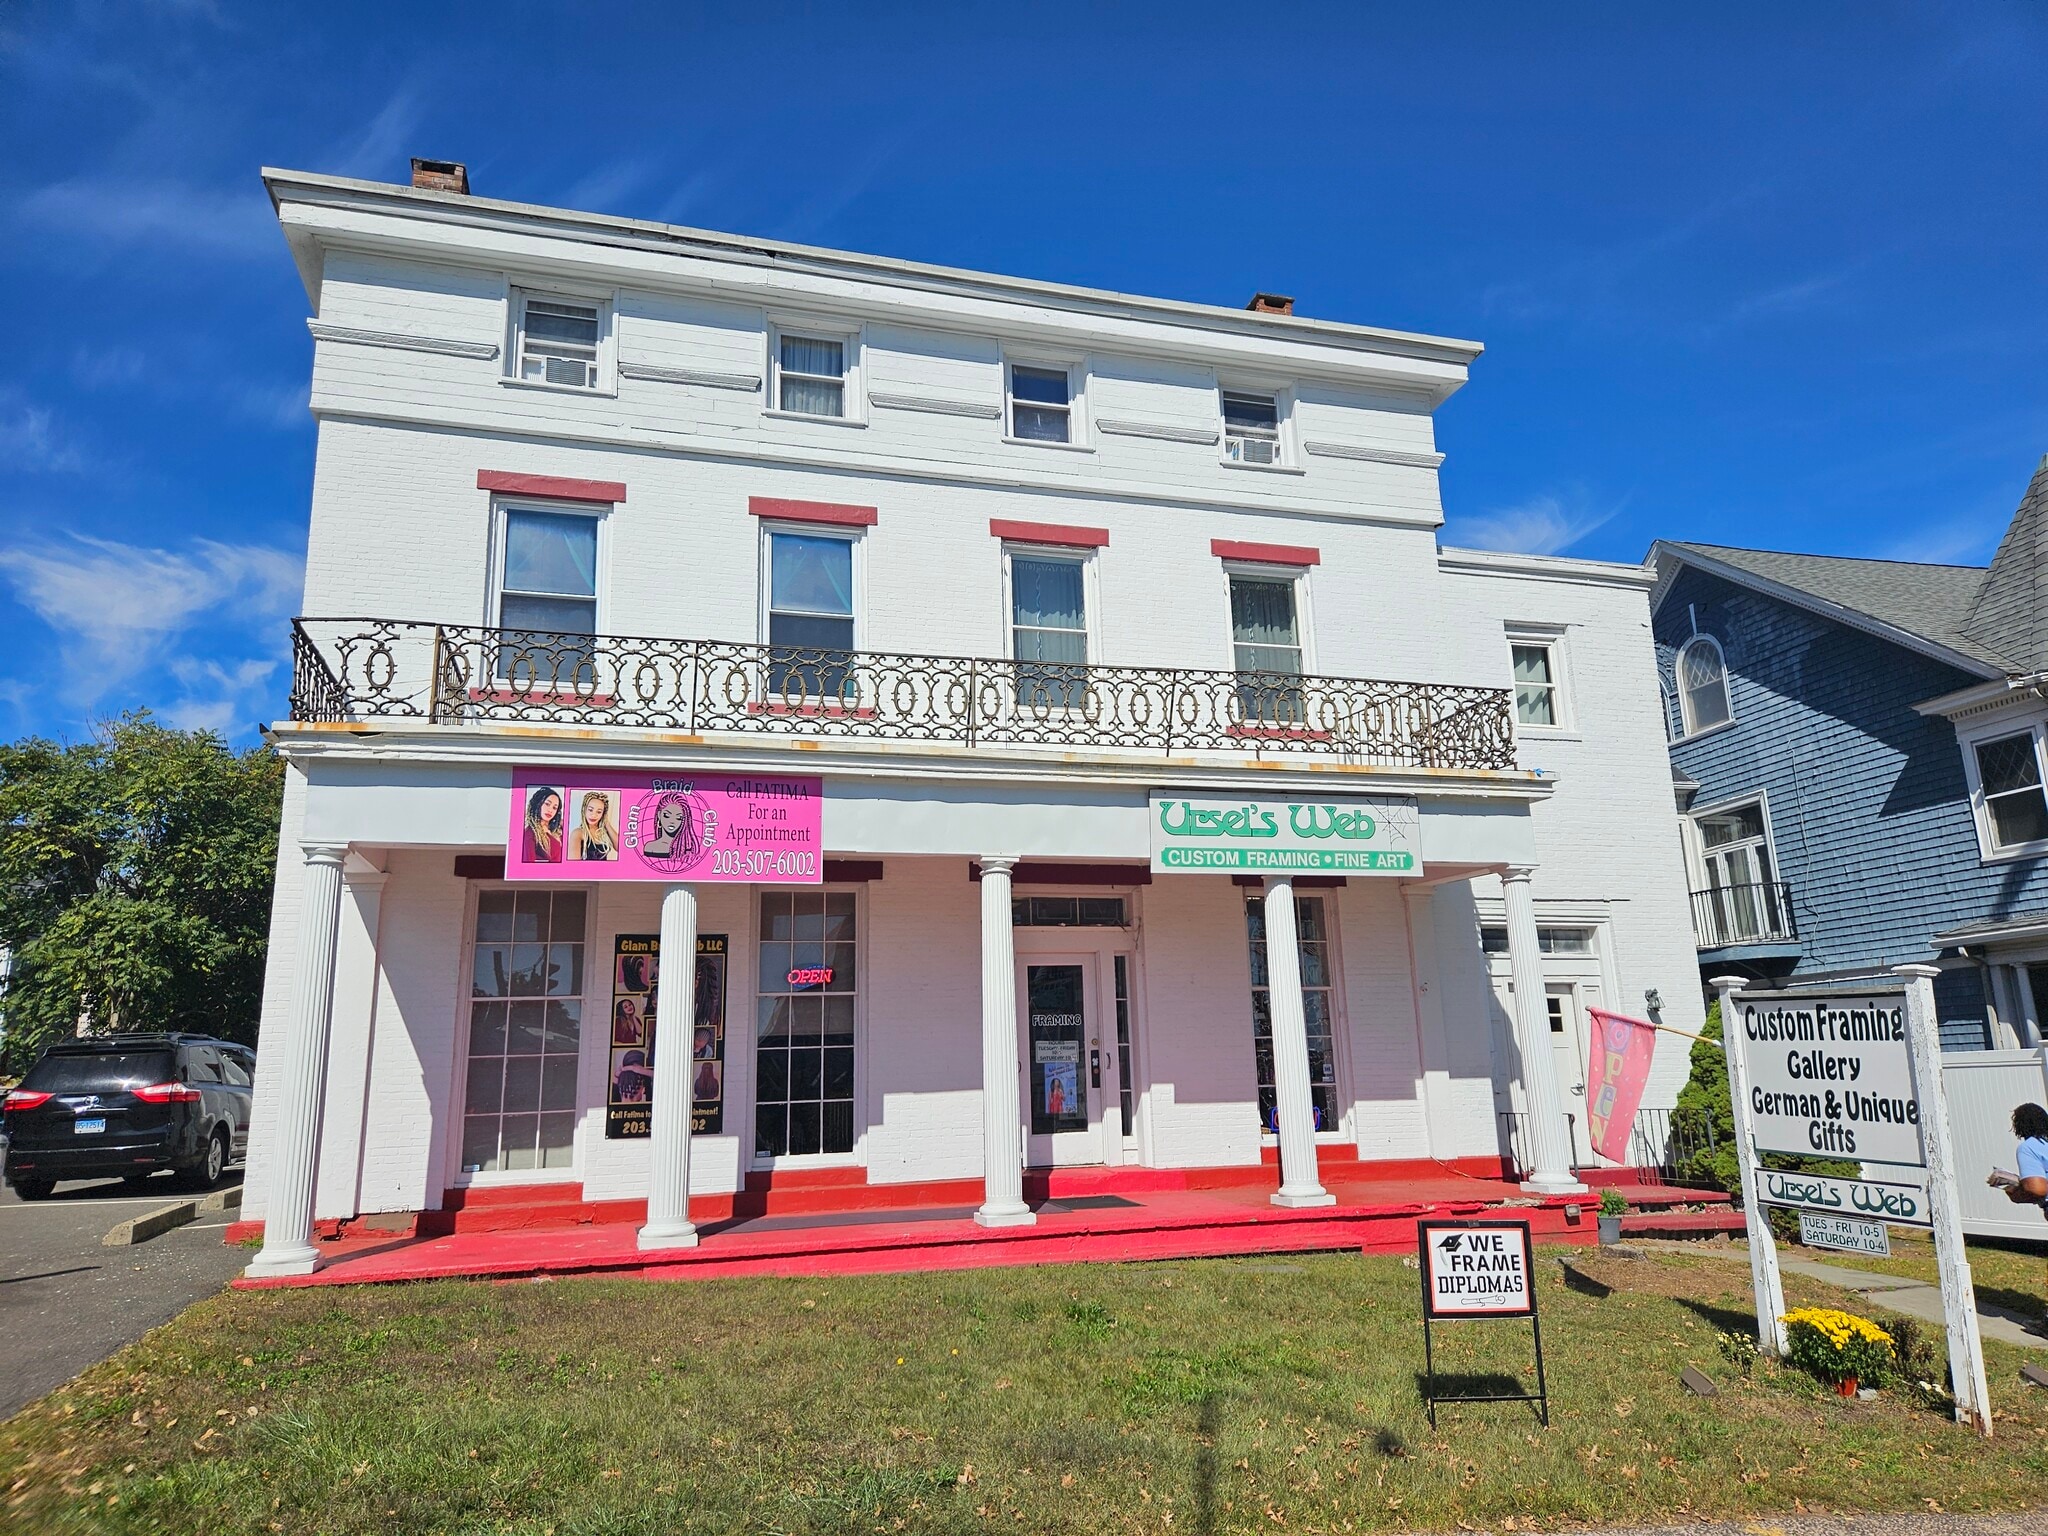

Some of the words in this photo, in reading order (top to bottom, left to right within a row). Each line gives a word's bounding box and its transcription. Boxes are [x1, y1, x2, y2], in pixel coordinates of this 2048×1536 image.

[652, 778, 694, 796] Braid
[726, 780, 752, 799] Call
[755, 782, 809, 801] FATIMA
[748, 803, 769, 820] For
[771, 808, 787, 821] an
[1159, 801, 1278, 838] Ursel's
[1288, 805, 1376, 839] Web
[624, 805, 641, 848] Glam
[703, 809, 719, 847] Club
[726, 825, 810, 846] Appointment
[711, 849, 816, 876] 203-507-6002
[1168, 849, 1239, 866] CUSTOM
[1247, 851, 1320, 867] FRAMING
[1335, 852, 1370, 867] FINE
[1376, 853, 1407, 868] ART
[621, 939, 648, 951] Glam
[706, 939, 723, 951] LLC
[787, 969, 832, 984] OPEN
[1032, 1014, 1082, 1026] FRAMING
[1744, 1004, 1815, 1042] Custom
[1816, 1001, 1905, 1042] Framing
[1787, 1050, 1861, 1081] Gallery
[611, 1110, 623, 1119] Call
[1752, 1086, 1820, 1118] German
[1824, 1089, 1842, 1120] &
[1845, 1090, 1919, 1125] Unique
[1808, 1120, 1857, 1154] Gifts
[1767, 1174, 1842, 1207] Ursel's
[1850, 1184, 1917, 1217] Web
[1802, 1216, 1827, 1230] TUES
[1835, 1221, 1852, 1233] FRI
[1859, 1225, 1880, 1237] 10-5
[1467, 1235, 1504, 1252] WE
[1806, 1229, 1860, 1247] SATURDAY
[1863, 1238, 1884, 1251] 10-4
[1451, 1254, 1521, 1272] FRAME
[1438, 1275, 1523, 1294] DIPLOMAS
